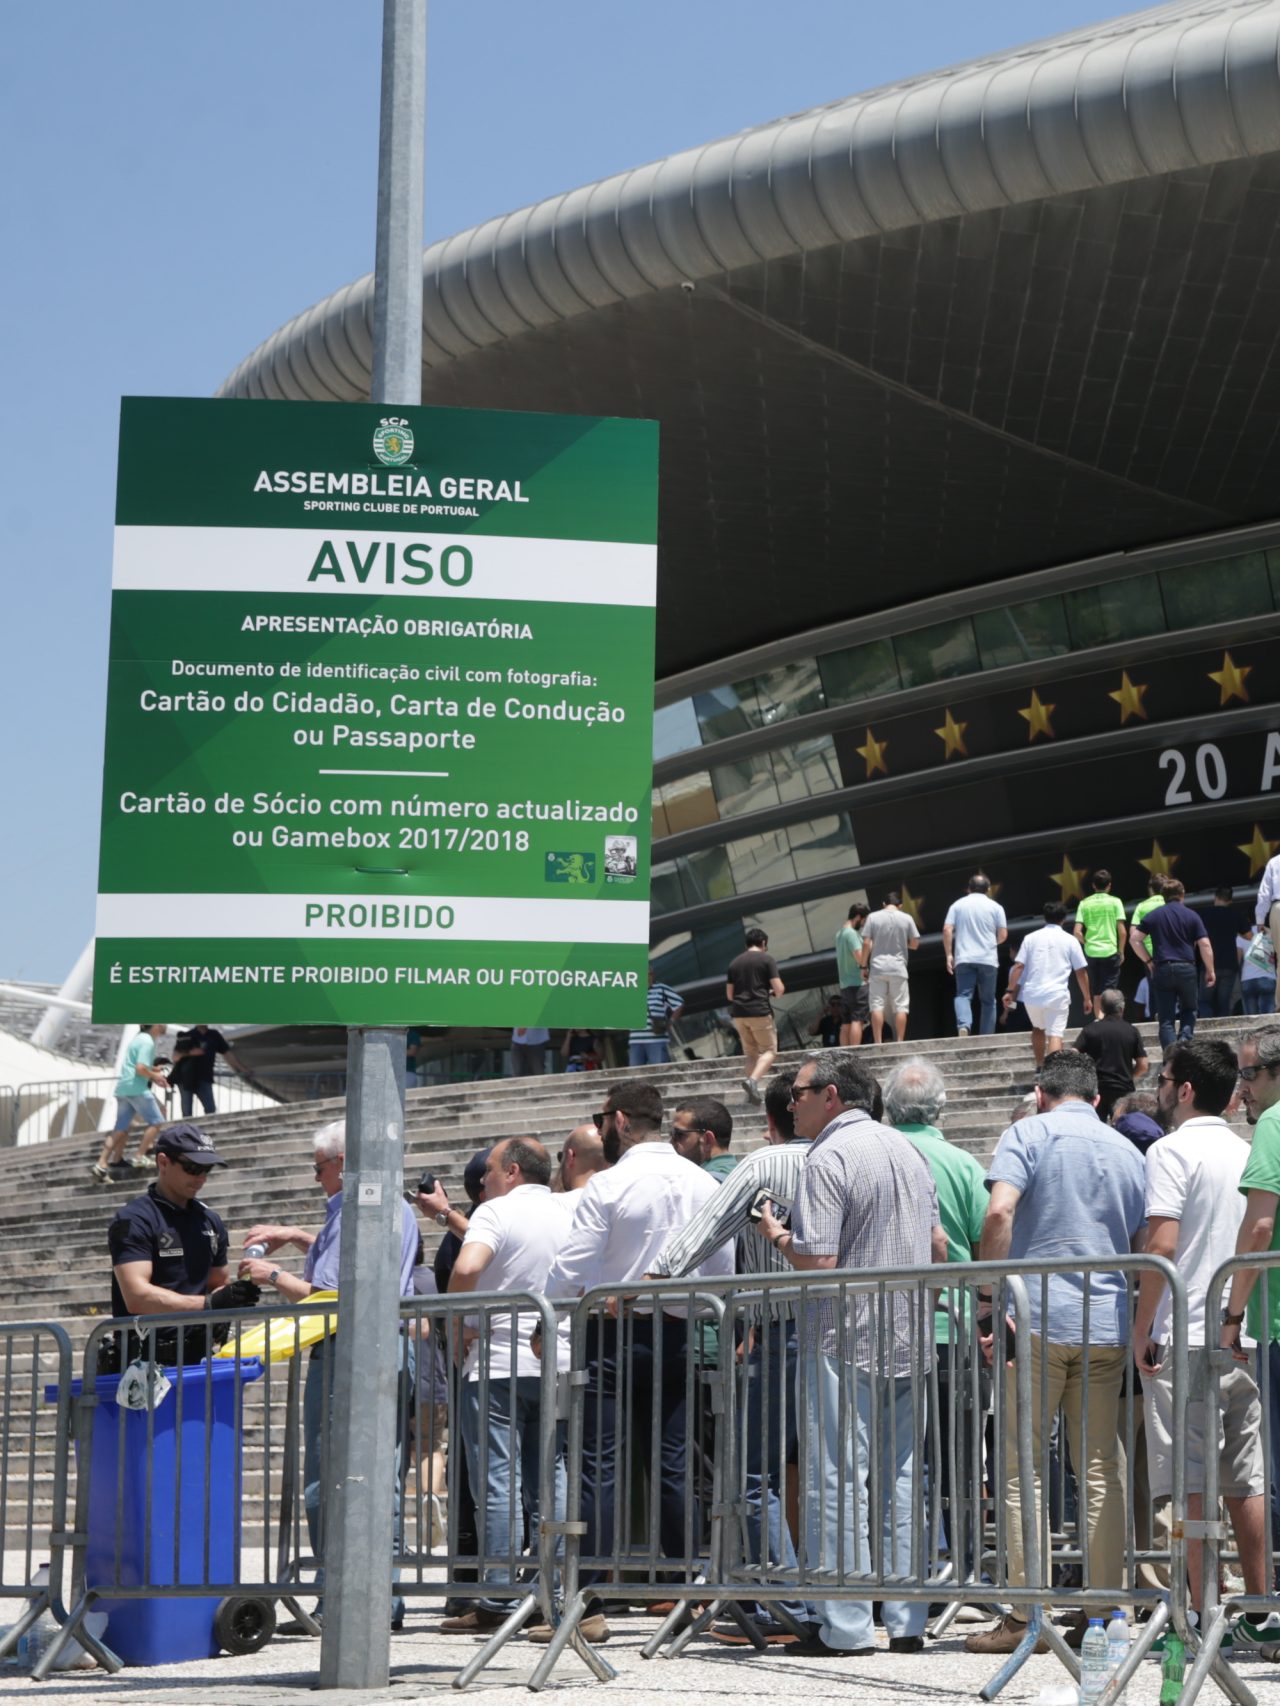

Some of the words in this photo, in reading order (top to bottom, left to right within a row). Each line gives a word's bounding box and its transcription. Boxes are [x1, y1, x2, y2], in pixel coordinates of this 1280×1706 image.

[380, 416, 409, 427] SCP
[253, 470, 433, 498] ASSEMBLEIA
[439, 477, 530, 503] GERAL
[303, 500, 361, 512] SPORTING
[362, 502, 401, 514] CLUBE
[402, 503, 418, 514] DE
[420, 504, 480, 517] PORTUGAL
[307, 540, 473, 587] AVISO
[240, 614, 399, 638] APRESENTAÇÃO
[403, 617, 534, 640] OBRIGATÓRIA
[171, 659, 275, 677] Documento
[279, 661, 302, 678] de
[306, 662, 420, 684] identificação
[424, 665, 461, 682] civil
[465, 670, 502, 683] com
[507, 668, 597, 689] fotografia:
[140, 689, 226, 712] Cartão
[233, 690, 264, 713] do
[272, 691, 382, 718] Cidadão,
[390, 694, 459, 717] Carta
[466, 696, 497, 718] de
[504, 697, 625, 727] Condução
[293, 729, 324, 746] ou
[333, 724, 476, 753] Passaporte
[1158, 742, 1228, 806] 20
[120, 791, 207, 814] Cartão
[214, 792, 245, 814] de
[252, 791, 322, 815] Sócio
[329, 799, 382, 816] com
[391, 794, 489, 819] número
[496, 799, 639, 823] actualizado
[232, 830, 263, 847] ou
[271, 825, 391, 849] Gamebox
[398, 827, 530, 852] 2017/2018
[305, 903, 455, 929] PROIBIDO
[110, 961, 123, 984] É
[128, 966, 286, 984] ESTRITAMENTE
[291, 966, 389, 984] PROIBIDO
[395, 967, 471, 985] FILMAR
[476, 968, 504, 986] OU
[510, 968, 638, 988] FOTOGRAFAR
